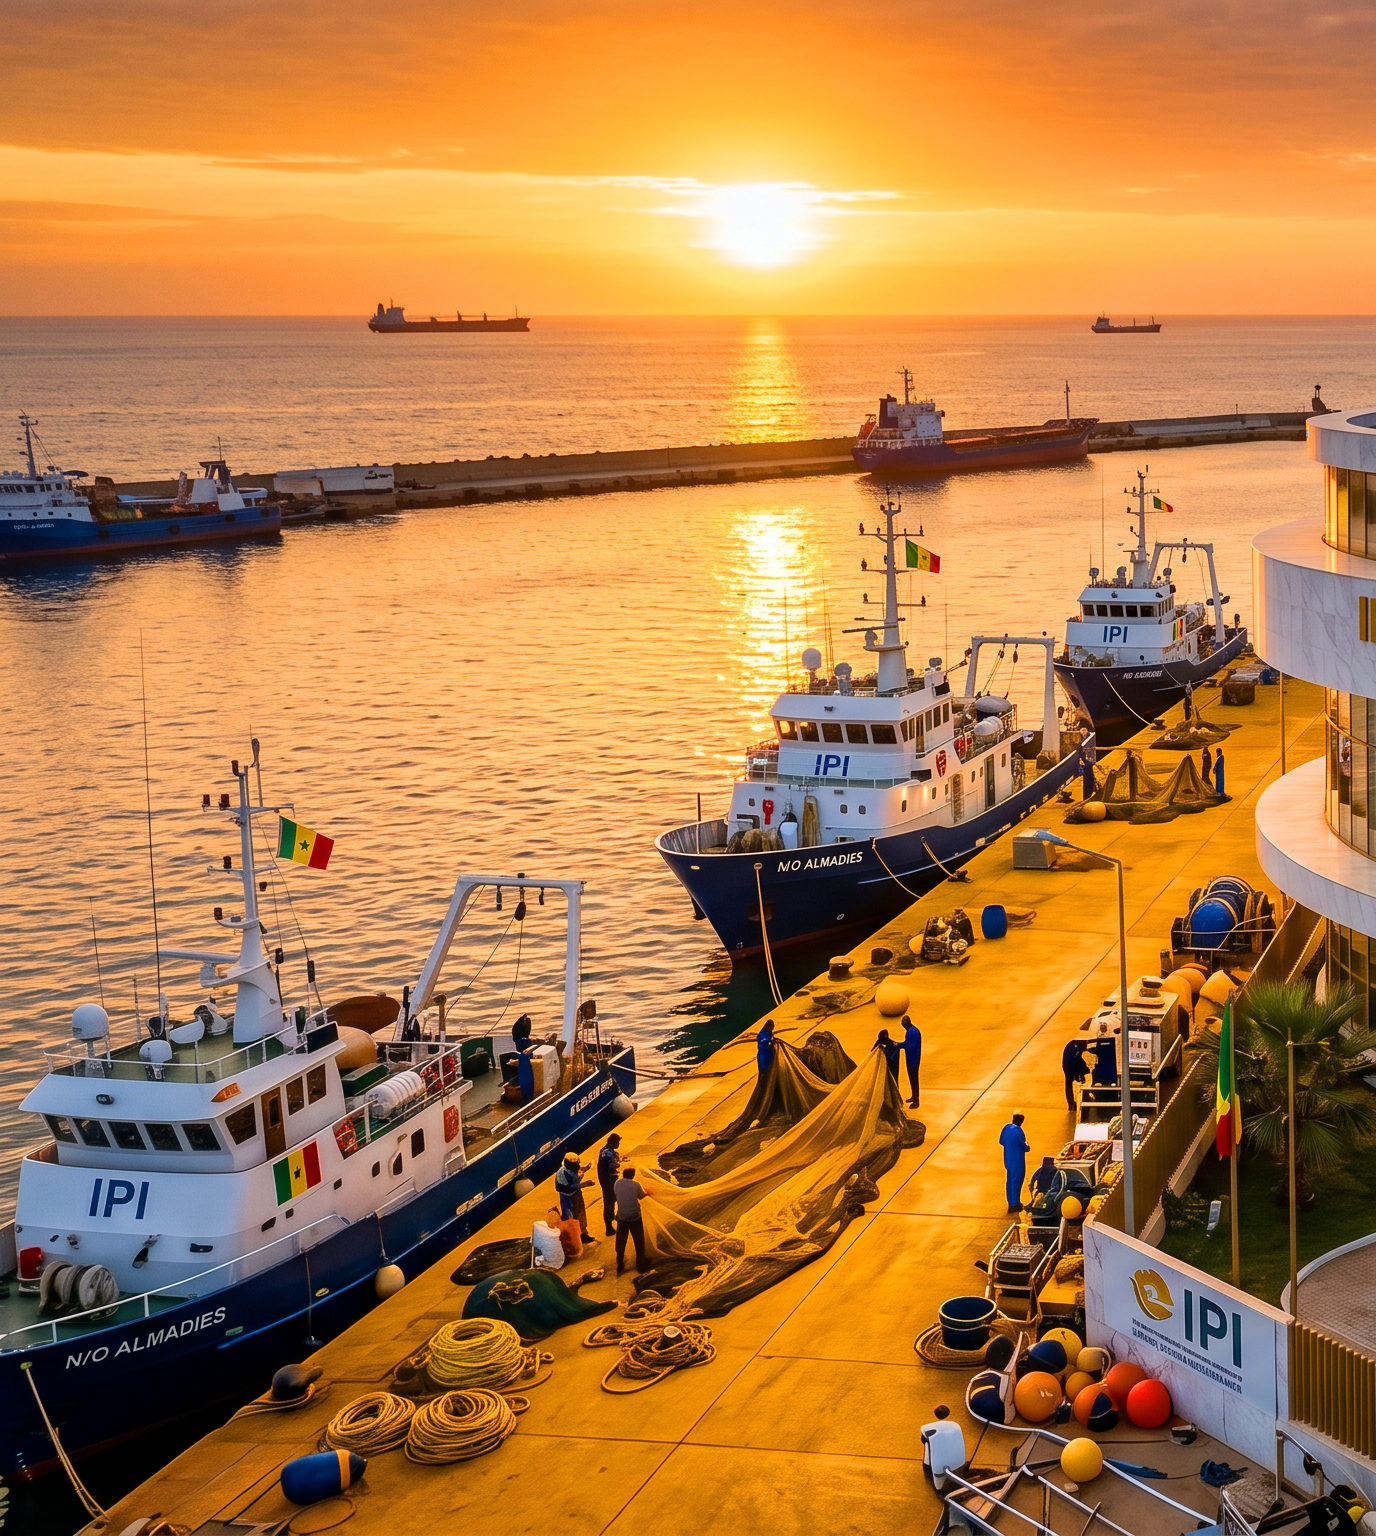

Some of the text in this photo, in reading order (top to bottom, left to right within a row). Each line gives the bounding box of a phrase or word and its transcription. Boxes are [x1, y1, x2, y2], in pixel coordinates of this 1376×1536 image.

[1103, 626, 1128, 643] IPI
[814, 754, 850, 777] IPI
[804, 851, 863, 870] ALMADIES
[89, 1178, 150, 1220] IPI
[66, 1307, 226, 1370] N/O ALMADIES
[1184, 1288, 1242, 1369] IPI
